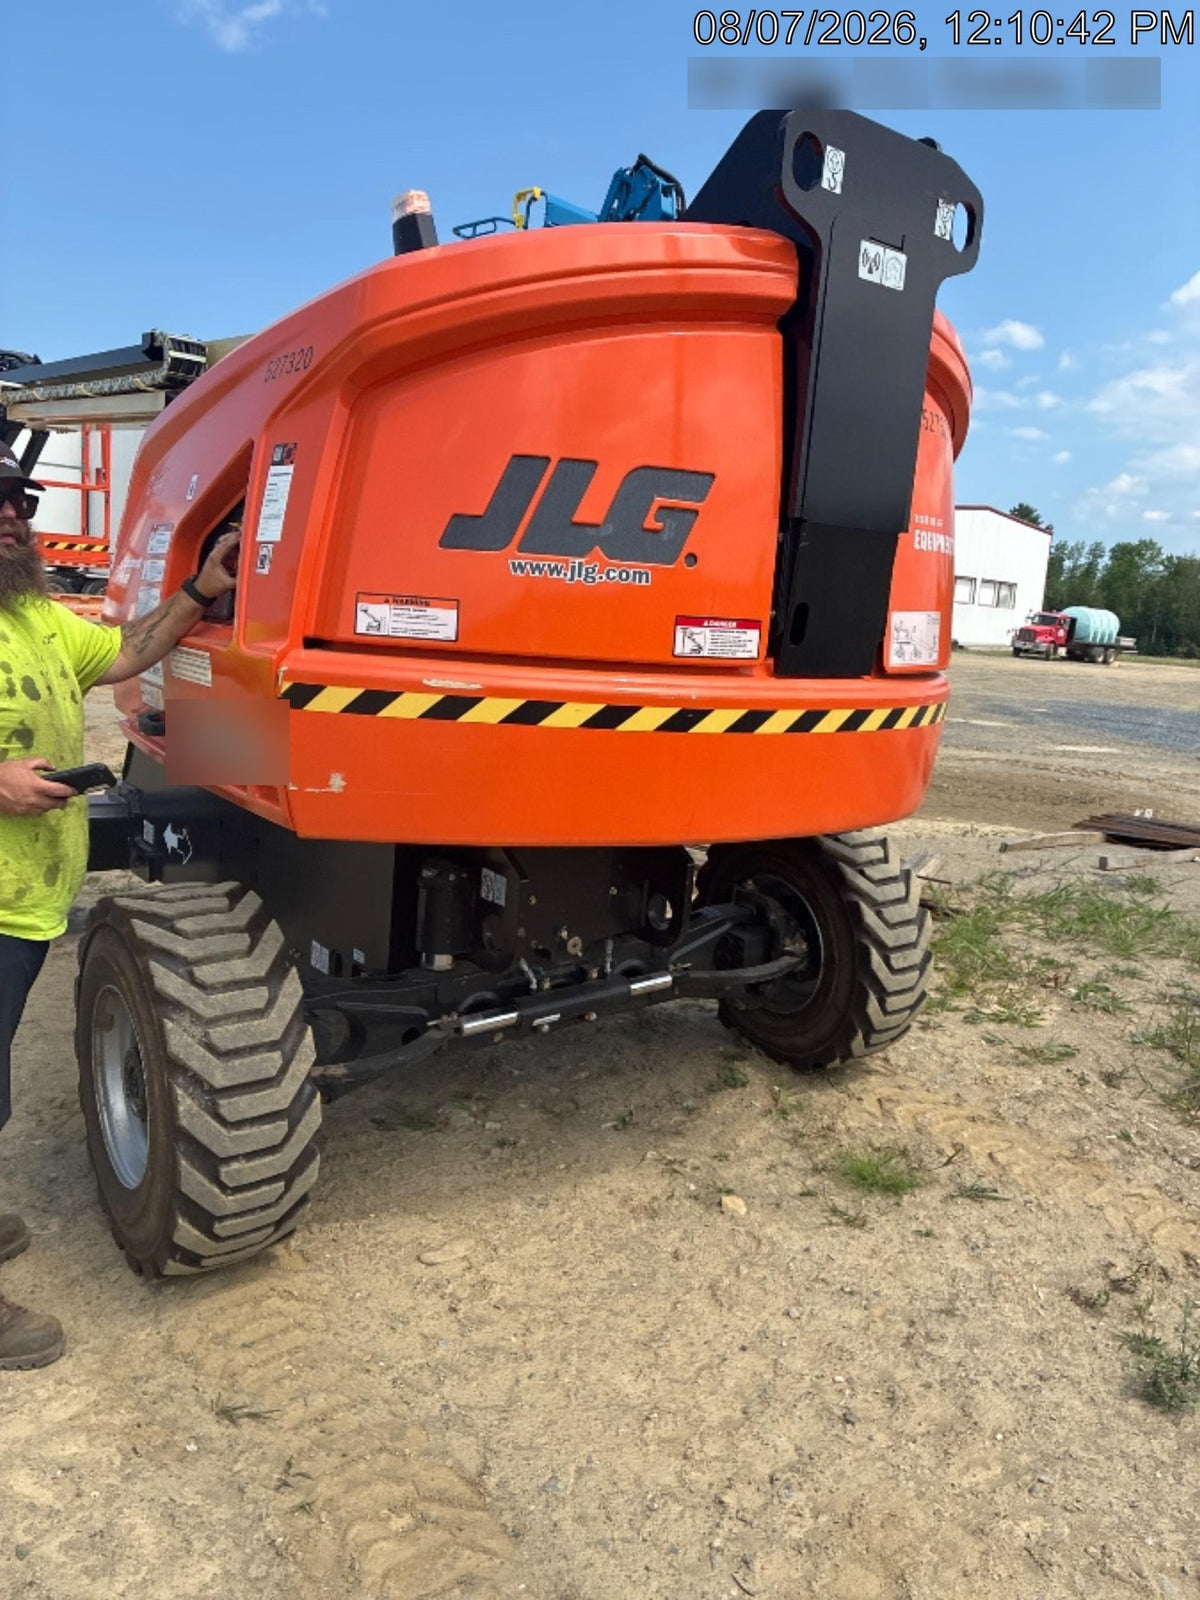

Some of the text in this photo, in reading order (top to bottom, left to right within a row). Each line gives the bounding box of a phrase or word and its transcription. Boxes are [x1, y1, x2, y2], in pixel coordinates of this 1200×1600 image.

[264, 345, 313, 383] 527320
[438, 454, 716, 567] JLG
[508, 559, 651, 585] www.jlg.com
